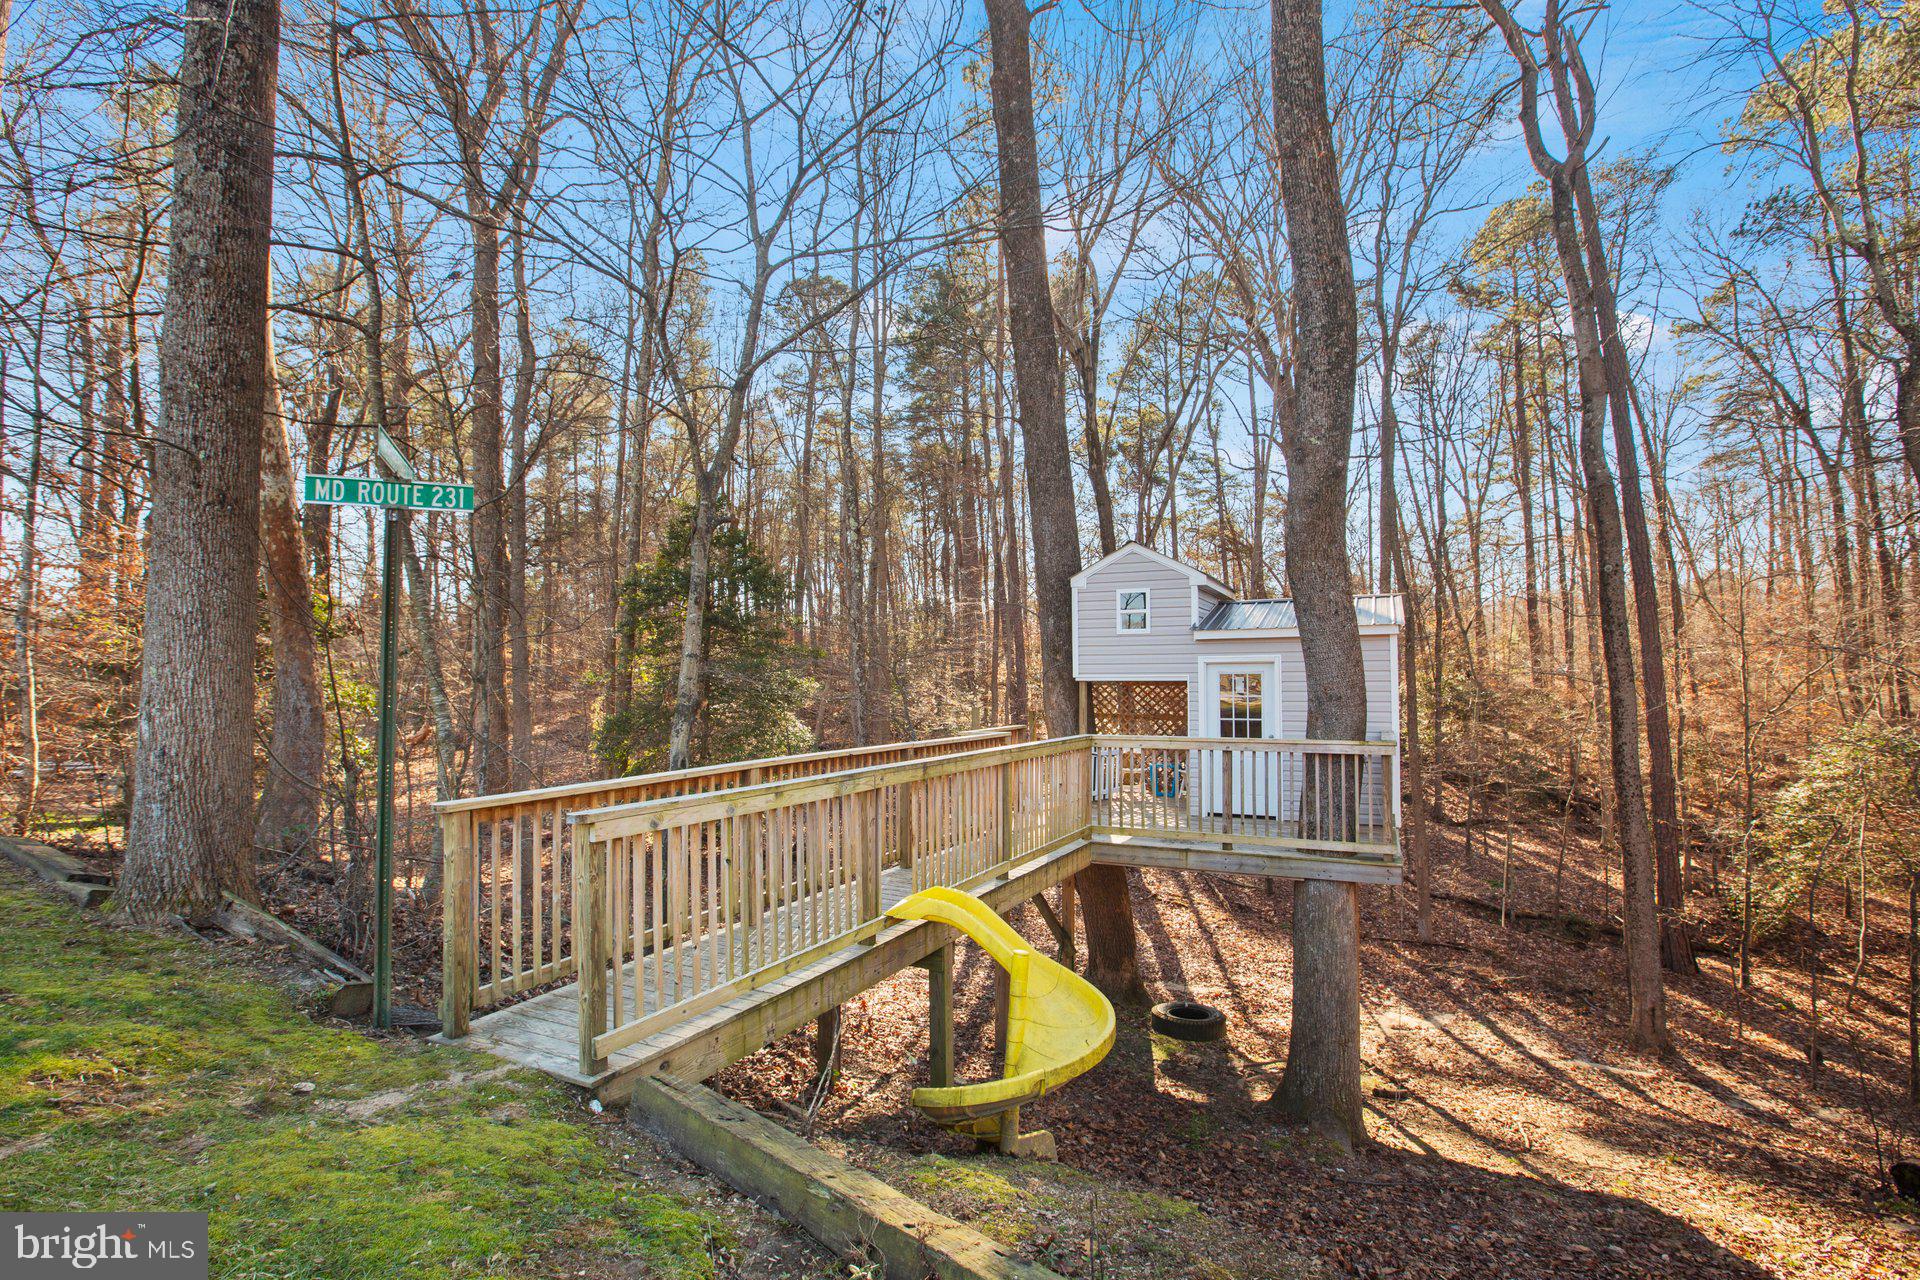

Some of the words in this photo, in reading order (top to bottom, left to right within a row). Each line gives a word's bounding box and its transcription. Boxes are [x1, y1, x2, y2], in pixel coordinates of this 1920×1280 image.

[314, 478, 345, 501] MD
[357, 481, 424, 506] ROUTE
[431, 486, 465, 508] 231
